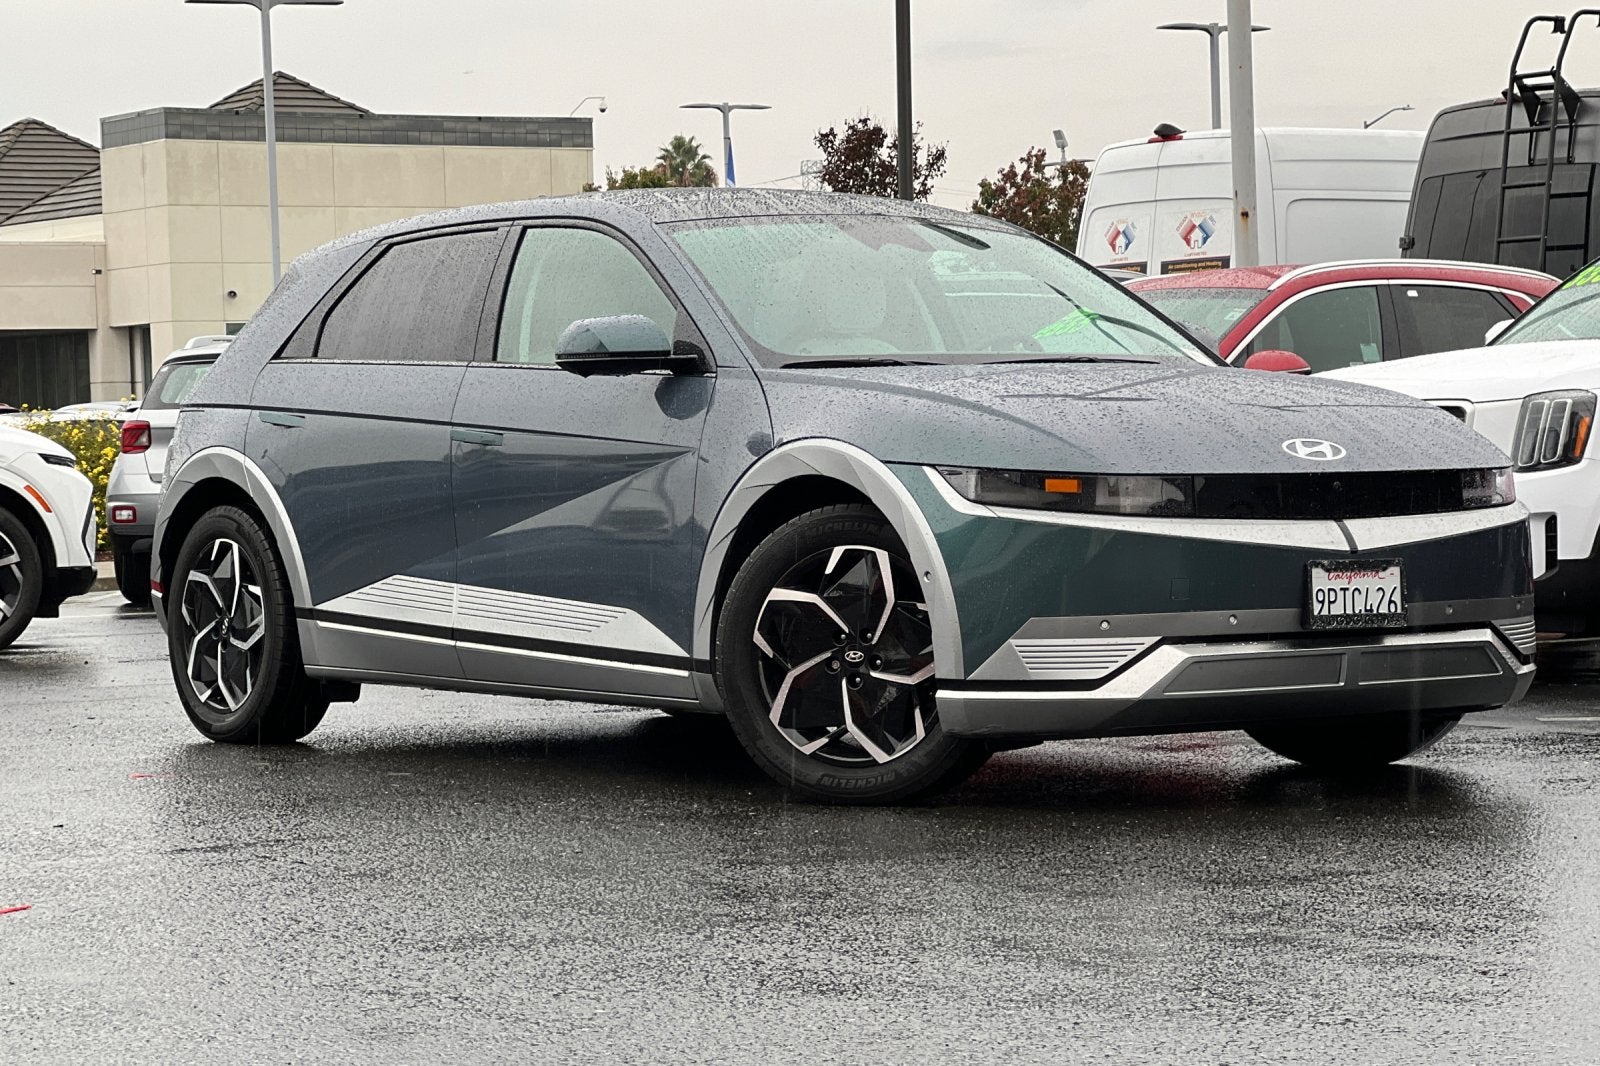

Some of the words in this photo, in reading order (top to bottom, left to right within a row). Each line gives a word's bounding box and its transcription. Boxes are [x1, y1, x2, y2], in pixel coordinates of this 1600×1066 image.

[1327, 570, 1386, 585] California
[1315, 586, 1398, 614] 9PTC426
[821, 771, 896, 789] MICHELIN
